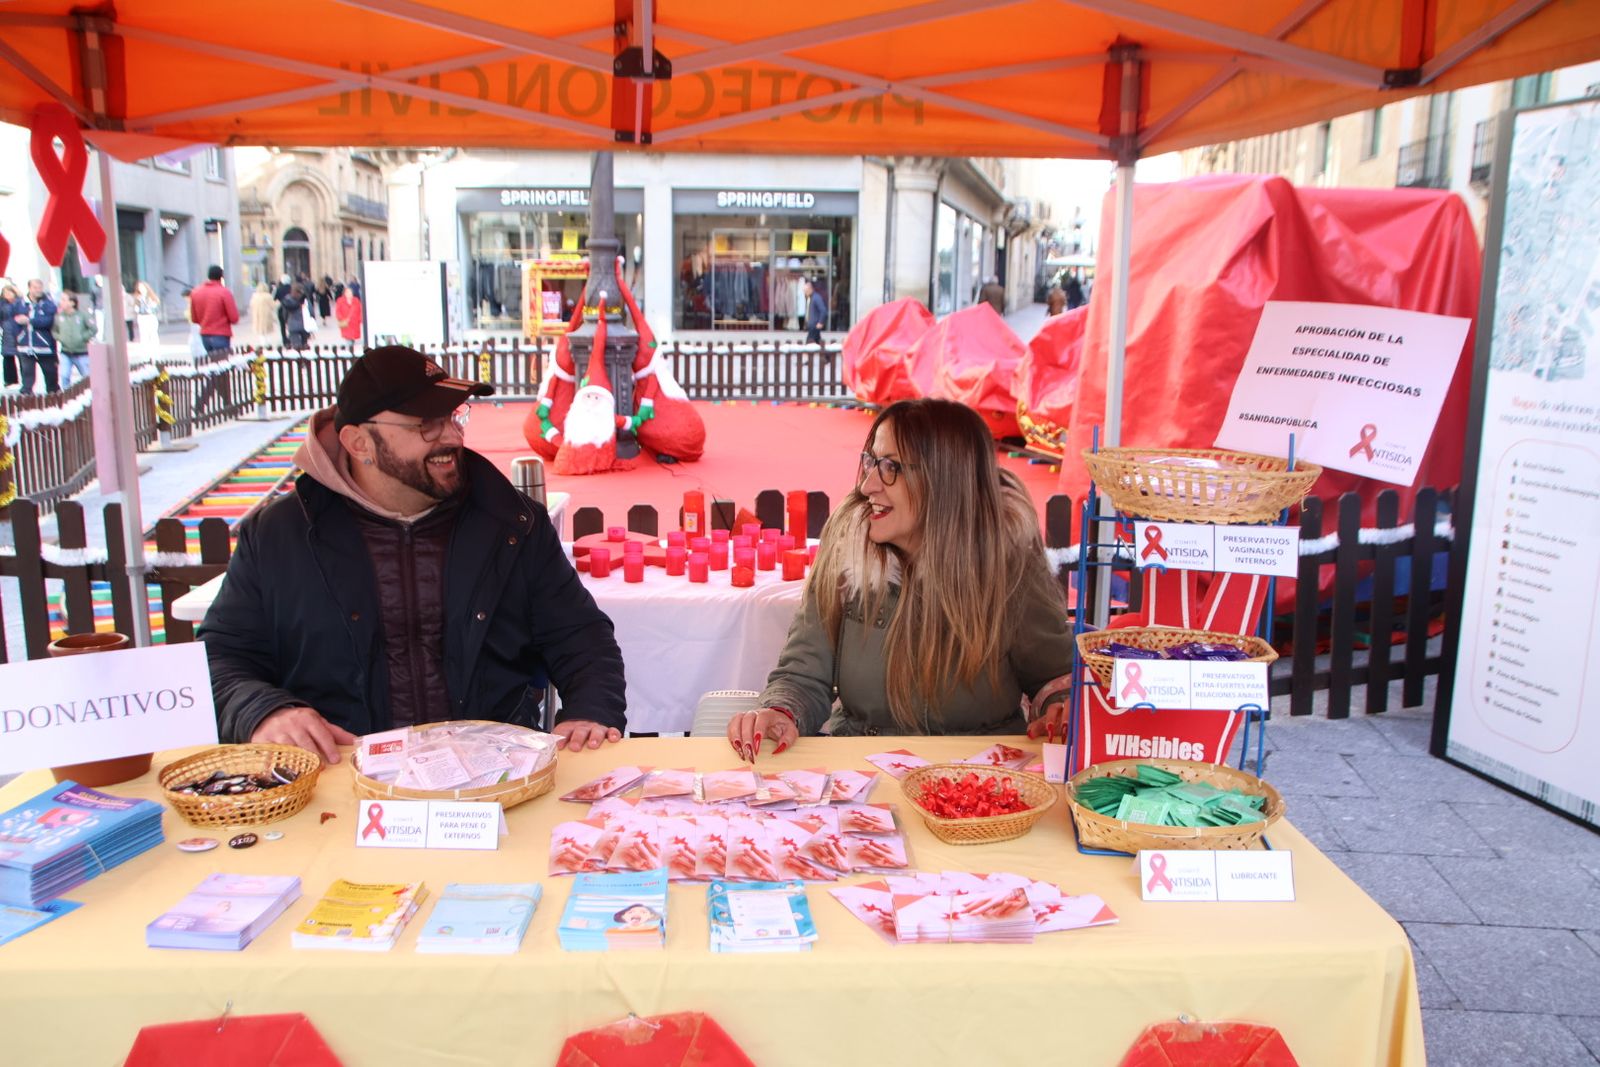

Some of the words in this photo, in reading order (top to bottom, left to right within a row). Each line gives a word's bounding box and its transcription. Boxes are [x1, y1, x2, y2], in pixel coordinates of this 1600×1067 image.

[500, 190, 588, 207] SPRINGFIEL
[716, 192, 815, 208] SPRINGFIELD
[1295, 325, 1365, 339] APROBACIÓN
[1368, 331, 1384, 342] DE
[1388, 334, 1404, 345] LA
[1292, 347, 1370, 364] ESPECIALIDAD
[1373, 356, 1390, 367] DE
[1256, 366, 1334, 381] ENFERMEDADES
[1337, 373, 1422, 397] INFECCIOSAS
[1239, 412, 1318, 429] #SANIDADPÚBLICA
[1223, 535, 1290, 546] PRESERVATIVOS
[1229, 546, 1275, 556] VAGINALES
[1235, 557, 1277, 566] INTERNOS
[1202, 672, 1256, 680] PRESERVATIVOS
[1193, 681, 1245, 690] EXTRA-FUERTES
[1246, 682, 1265, 690] PARA
[1195, 691, 1236, 699] RELACIONES
[1237, 691, 1264, 699] ANALES
[2, 686, 195, 733] DONATIVOS
[1105, 733, 1205, 761] VIHsibles
[435, 811, 492, 819] PRESERVATIVOS
[1231, 872, 1278, 880] LUBRICANTE
